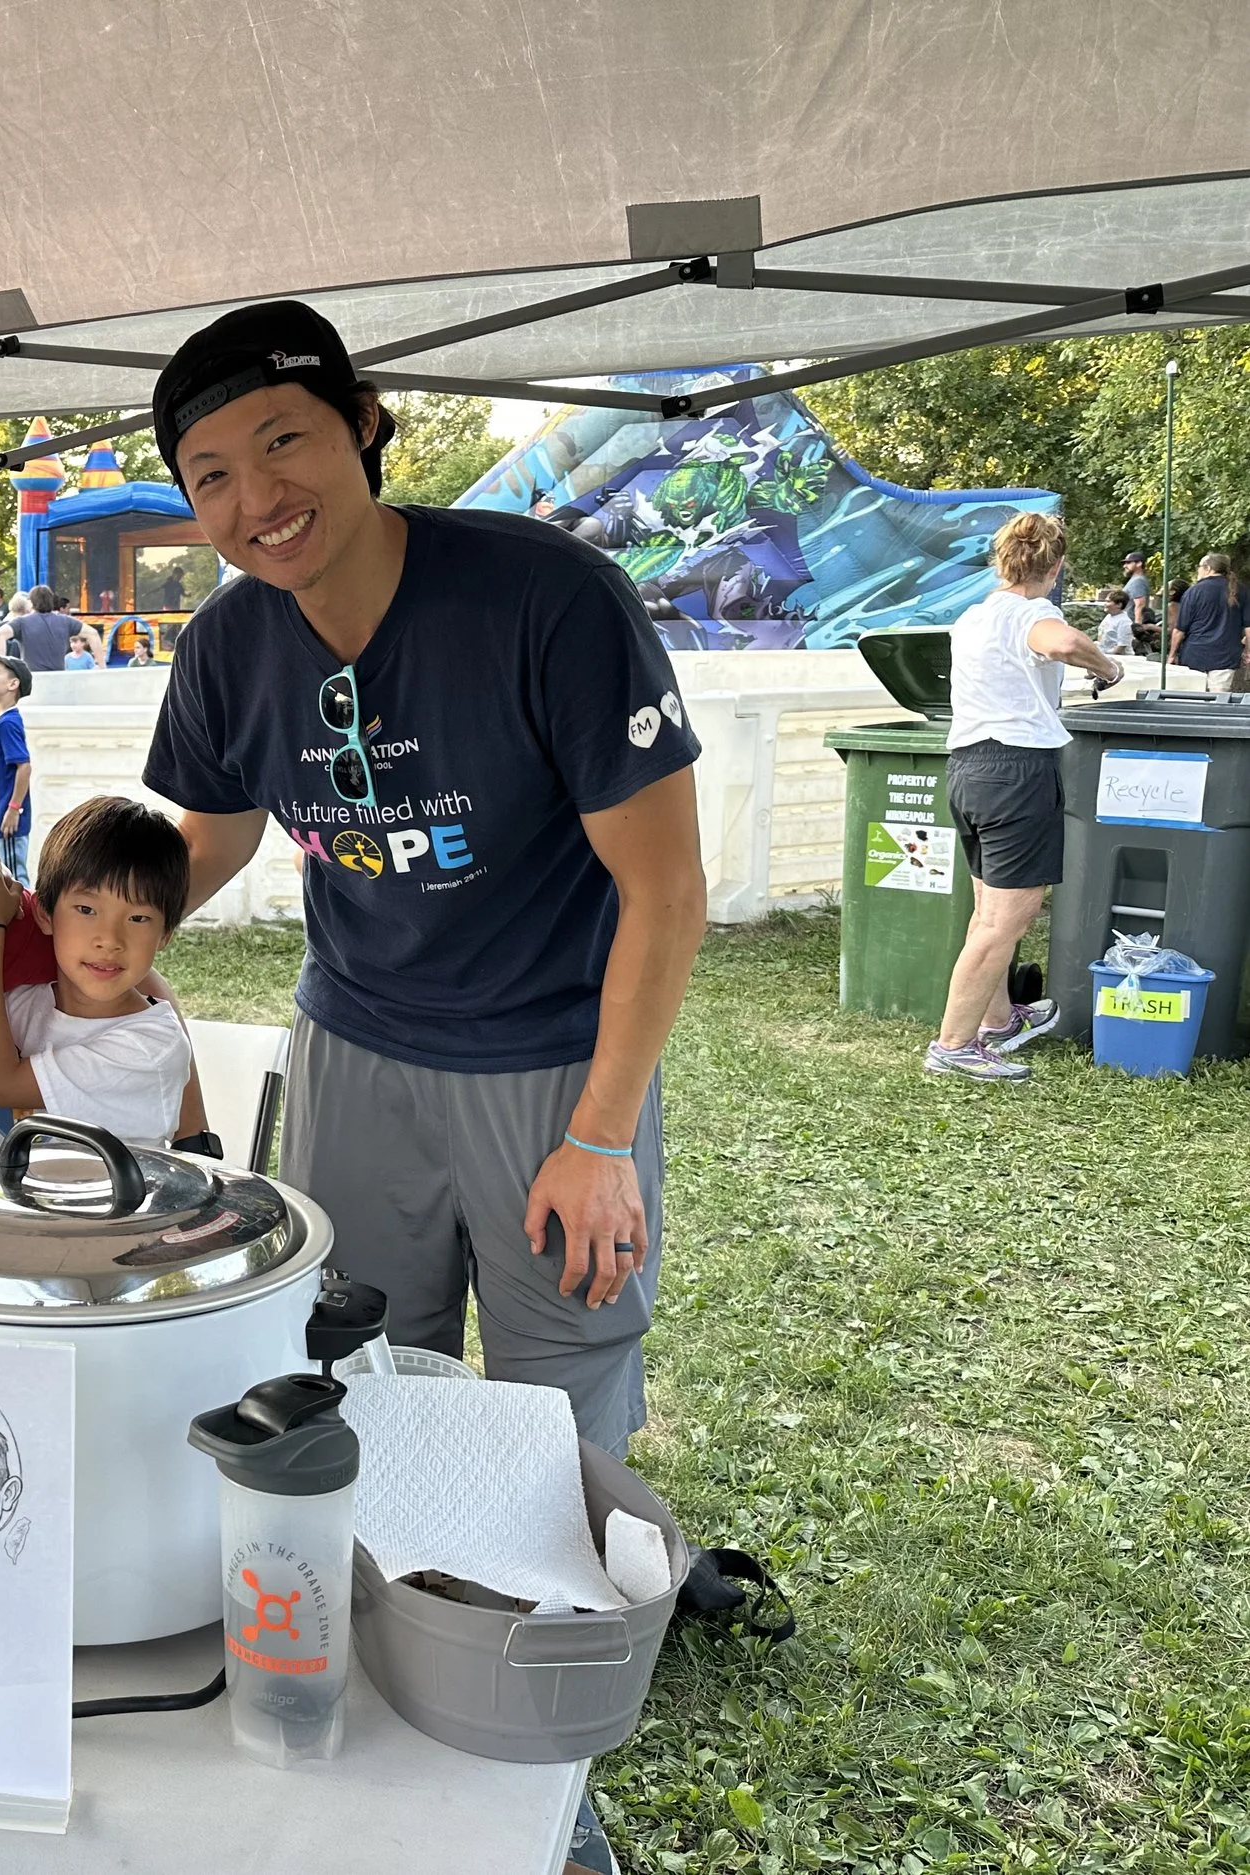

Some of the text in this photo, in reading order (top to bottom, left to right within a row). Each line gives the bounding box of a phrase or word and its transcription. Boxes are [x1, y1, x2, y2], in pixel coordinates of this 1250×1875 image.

[631, 717, 652, 738] FM
[887, 774, 938, 788] PROPERTY OF
[1105, 776, 1188, 806] Recycle
[292, 801, 350, 823] future
[355, 796, 413, 824] filled
[420, 790, 473, 816] with
[889, 792, 935, 806] THE CITY OF
[885, 810, 935, 823] MINNEAPOLIS
[1110, 995, 1172, 1015] TRASH
[246, 1541, 261, 1554] IN
[268, 1542, 295, 1562] THE
[297, 1562, 326, 1611] ORANGE
[319, 1615, 329, 1650] ZONE
